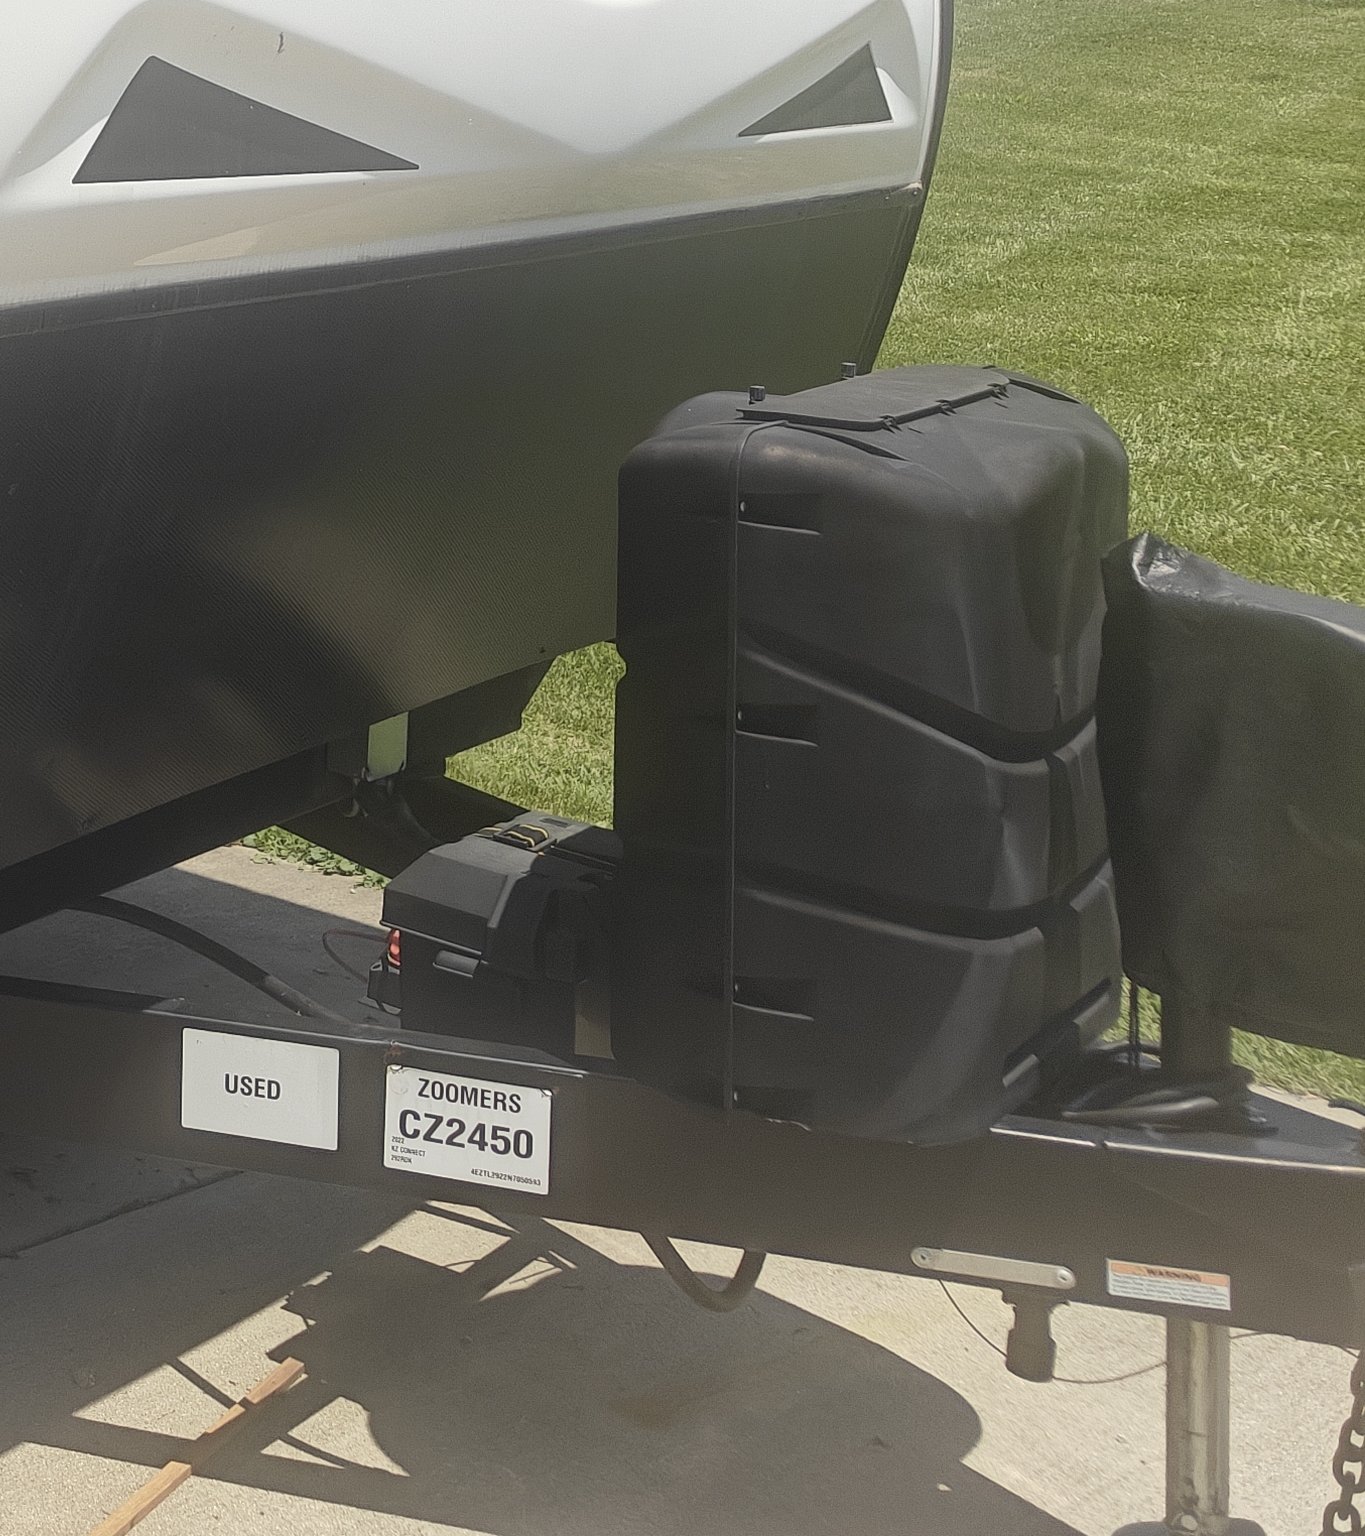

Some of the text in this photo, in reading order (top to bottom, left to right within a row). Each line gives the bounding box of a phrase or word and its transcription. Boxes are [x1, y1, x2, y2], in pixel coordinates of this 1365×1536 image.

[225, 1073, 282, 1100] USED
[418, 1078, 522, 1113] ZOOMERS
[399, 1109, 534, 1159] CZ2450
